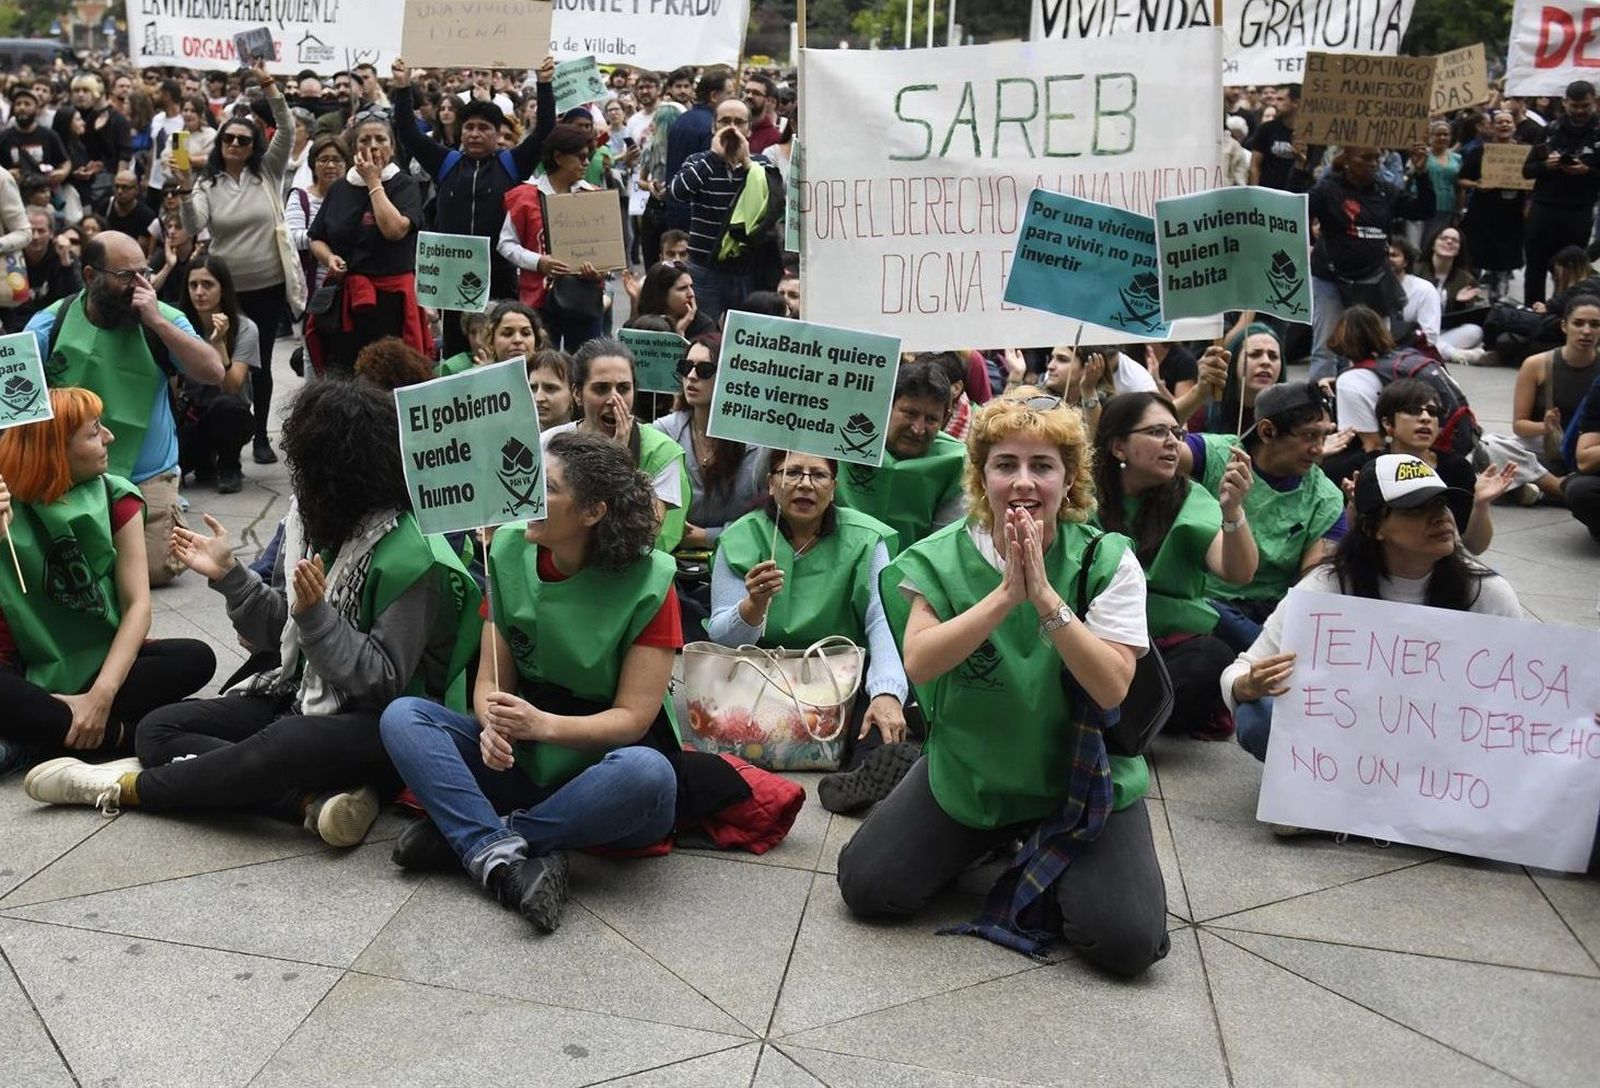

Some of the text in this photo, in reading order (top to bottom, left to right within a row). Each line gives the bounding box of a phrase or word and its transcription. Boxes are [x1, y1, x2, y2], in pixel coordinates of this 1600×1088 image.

[563, 37, 578, 51] de
[584, 37, 636, 55] Villalba
[1308, 55, 1432, 81] EL DOMINGO
[1313, 80, 1330, 93] SE
[1434, 81, 1474, 110] DAS
[888, 72, 1138, 162] SAREB
[1302, 123, 1313, 139] A
[1323, 117, 1358, 142] ANA
[798, 180, 847, 240] POR
[855, 179, 883, 239] EL
[890, 176, 1019, 236] DERECHO
[1031, 201, 1157, 246] Por una viviend
[1164, 207, 1298, 239] La vivienda para
[426, 243, 473, 260] gobierno
[1020, 244, 1083, 273] invertir
[1025, 224, 1159, 269] para vivir, no par
[1166, 235, 1240, 268] quien la
[881, 250, 985, 315] DIGNA
[1168, 265, 1228, 291] habita
[0, 346, 15, 358] da
[734, 328, 888, 369] CaixaBank quiere
[729, 353, 876, 393] desahuciar a Pili
[725, 378, 830, 411] este viernes
[409, 391, 511, 434] El gobierno
[721, 400, 836, 436] #PilarSeQueda
[412, 437, 472, 471] vende
[418, 482, 475, 510] humo
[1308, 611, 1571, 710] TENER CASA
[1302, 685, 1358, 729] ES
[1378, 694, 1438, 740] UN
[1291, 745, 1490, 809] NO UN LUJO
